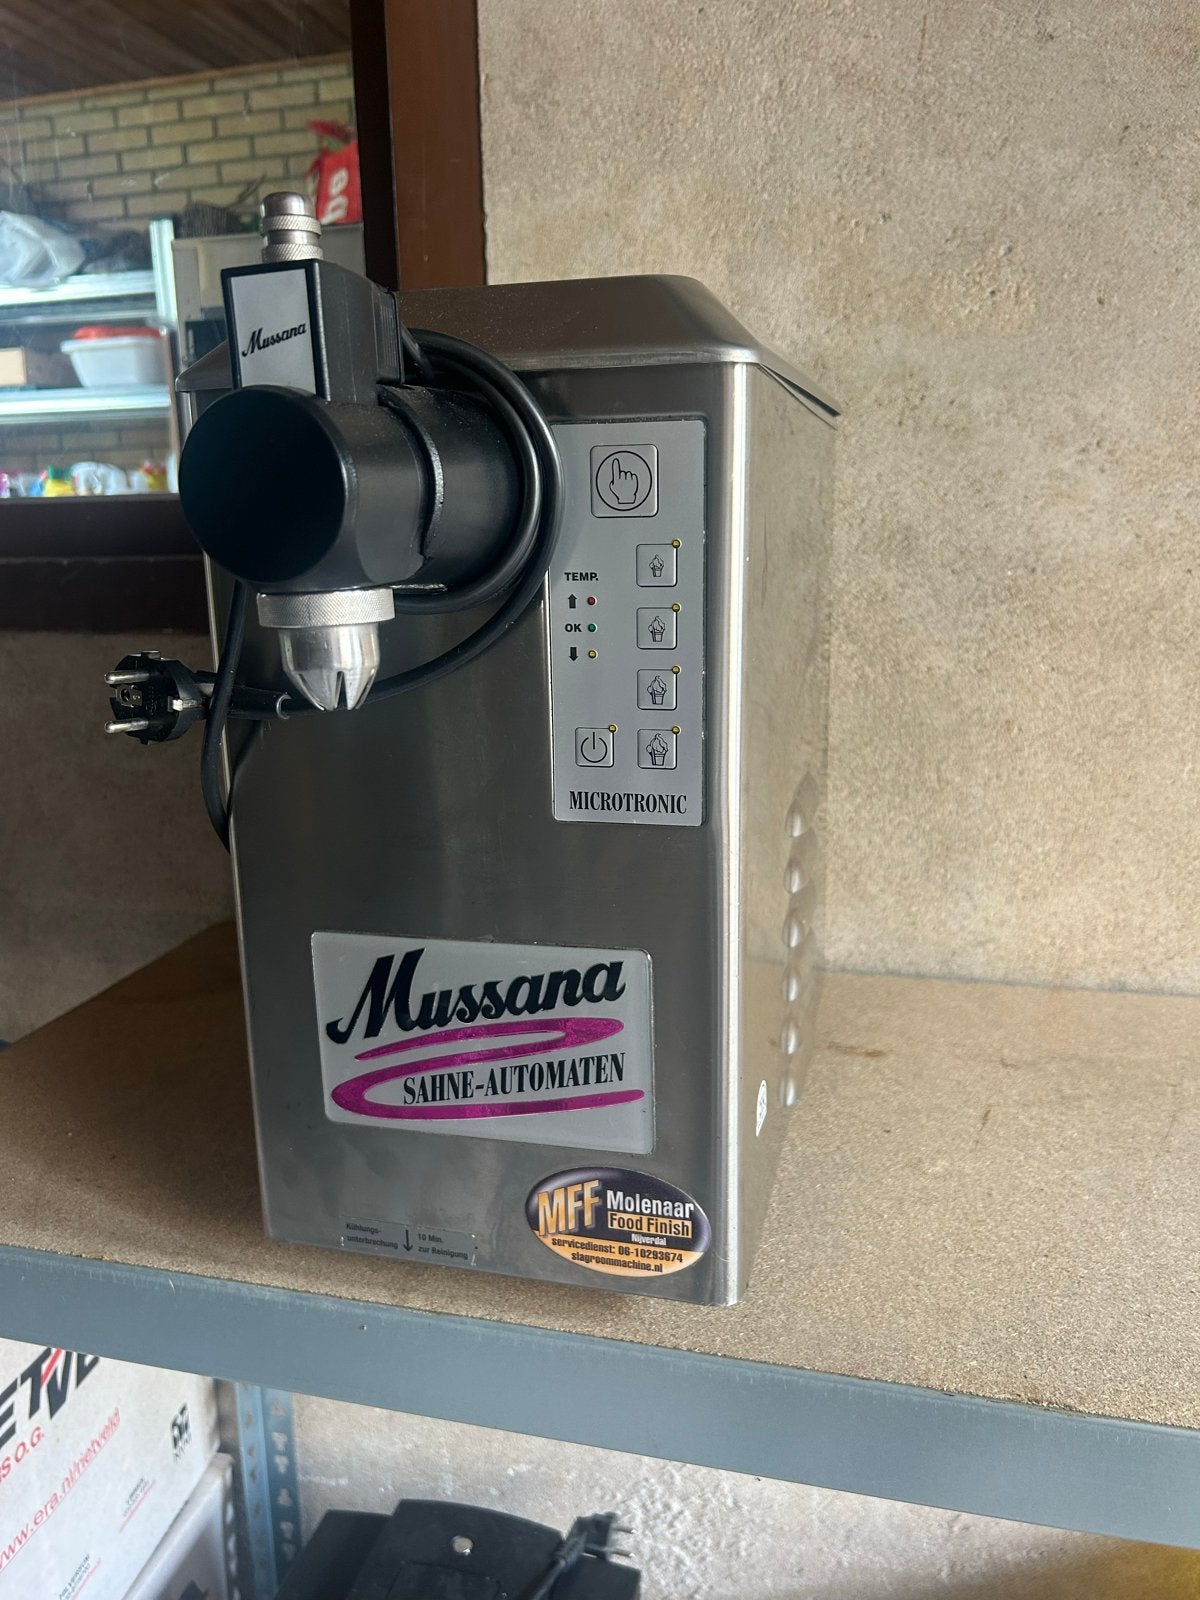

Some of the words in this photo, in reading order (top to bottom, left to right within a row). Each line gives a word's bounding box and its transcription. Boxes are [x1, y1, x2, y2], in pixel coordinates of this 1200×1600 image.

[242, 323, 307, 357] Mussana
[564, 572, 599, 582] TEMP.
[564, 623, 582, 633] OK
[569, 791, 687, 814] MICROTRONIC
[326, 948, 626, 1044] Mussana
[403, 1053, 626, 1105] SAHNE-AUTOMATEN
[537, 1179, 600, 1237] MFF
[606, 1189, 695, 1219] Molenaar
[609, 1212, 643, 1231] Food
[647, 1218, 690, 1237] Finish
[418, 1233, 427, 1241] 10
[428, 1234, 444, 1243] Min.
[551, 1237, 616, 1255] servicedienst:
[618, 1245, 684, 1263] 06-10293674
[631, 1233, 667, 1246] Nijverdal
[418, 1245, 430, 1254] zur
[431, 1246, 469, 1260] Reinigung
[571, 1252, 664, 1273] slagroommachine.nl
